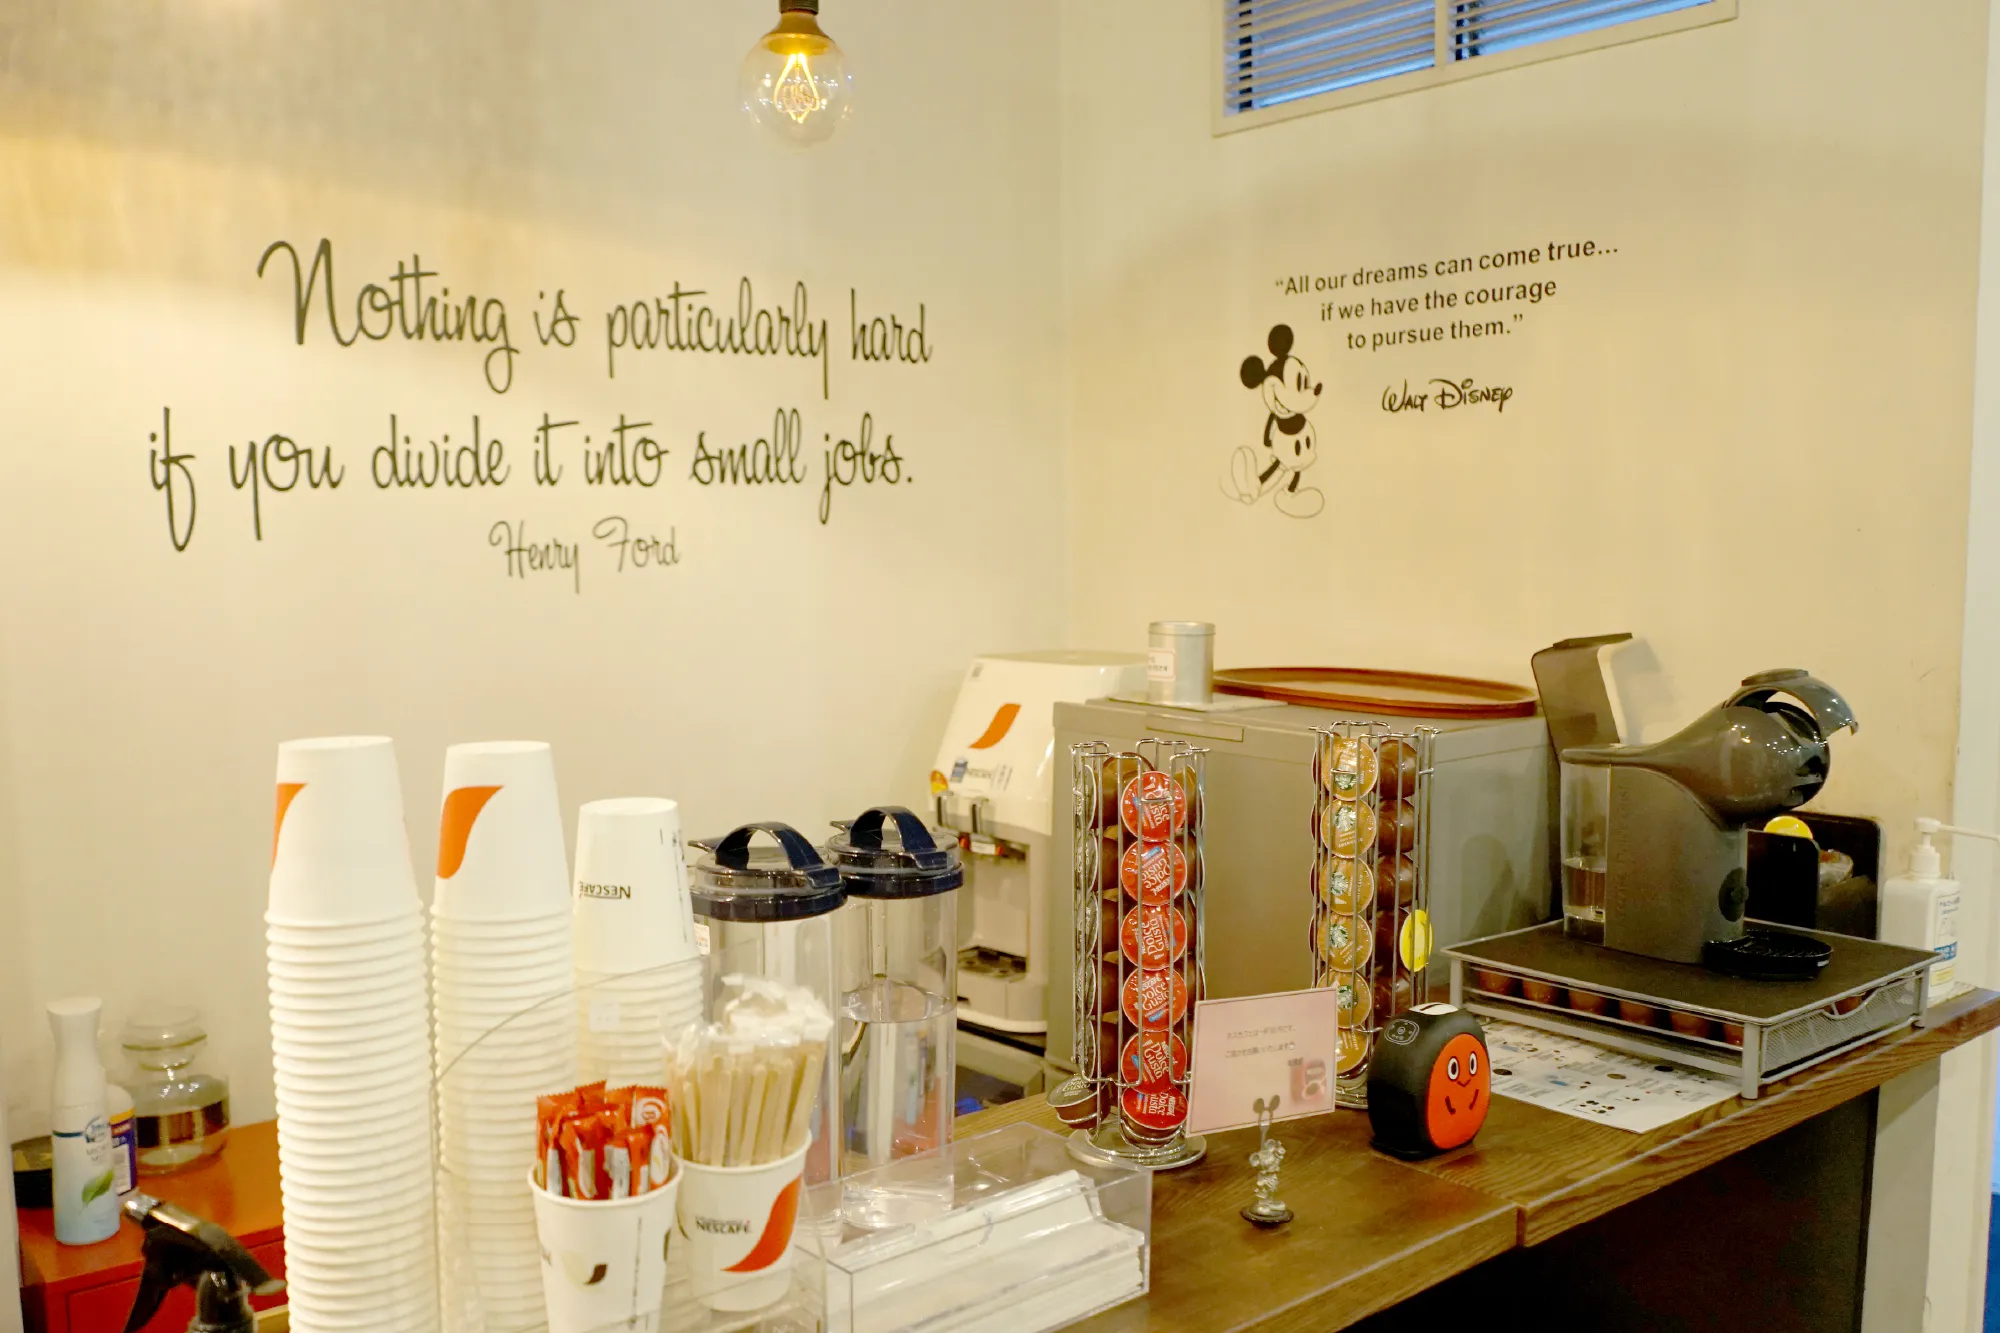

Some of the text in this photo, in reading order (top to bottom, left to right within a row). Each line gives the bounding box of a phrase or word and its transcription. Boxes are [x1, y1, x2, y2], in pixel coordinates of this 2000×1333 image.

[1315, 273, 1347, 292] our
[1352, 263, 1428, 287] dreams
[1435, 256, 1473, 276] can
[1479, 247, 1541, 270] come
[1321, 280, 1557, 321] if we have the courage
[257, 238, 933, 400] Nothing is particularly hard
[1347, 332, 1366, 349] to
[1372, 325, 1444, 352] pursue
[149, 406, 913, 552] if you divide it into small jobs.
[488, 516, 682, 595] Henry Ford
[1142, 921, 1157, 955] Dolce
[1149, 917, 1165, 952] Gusto
[1143, 1048, 1162, 1079] Gusto
[1150, 1041, 1169, 1074] Dolce
[1148, 1094, 1159, 1114] usto
